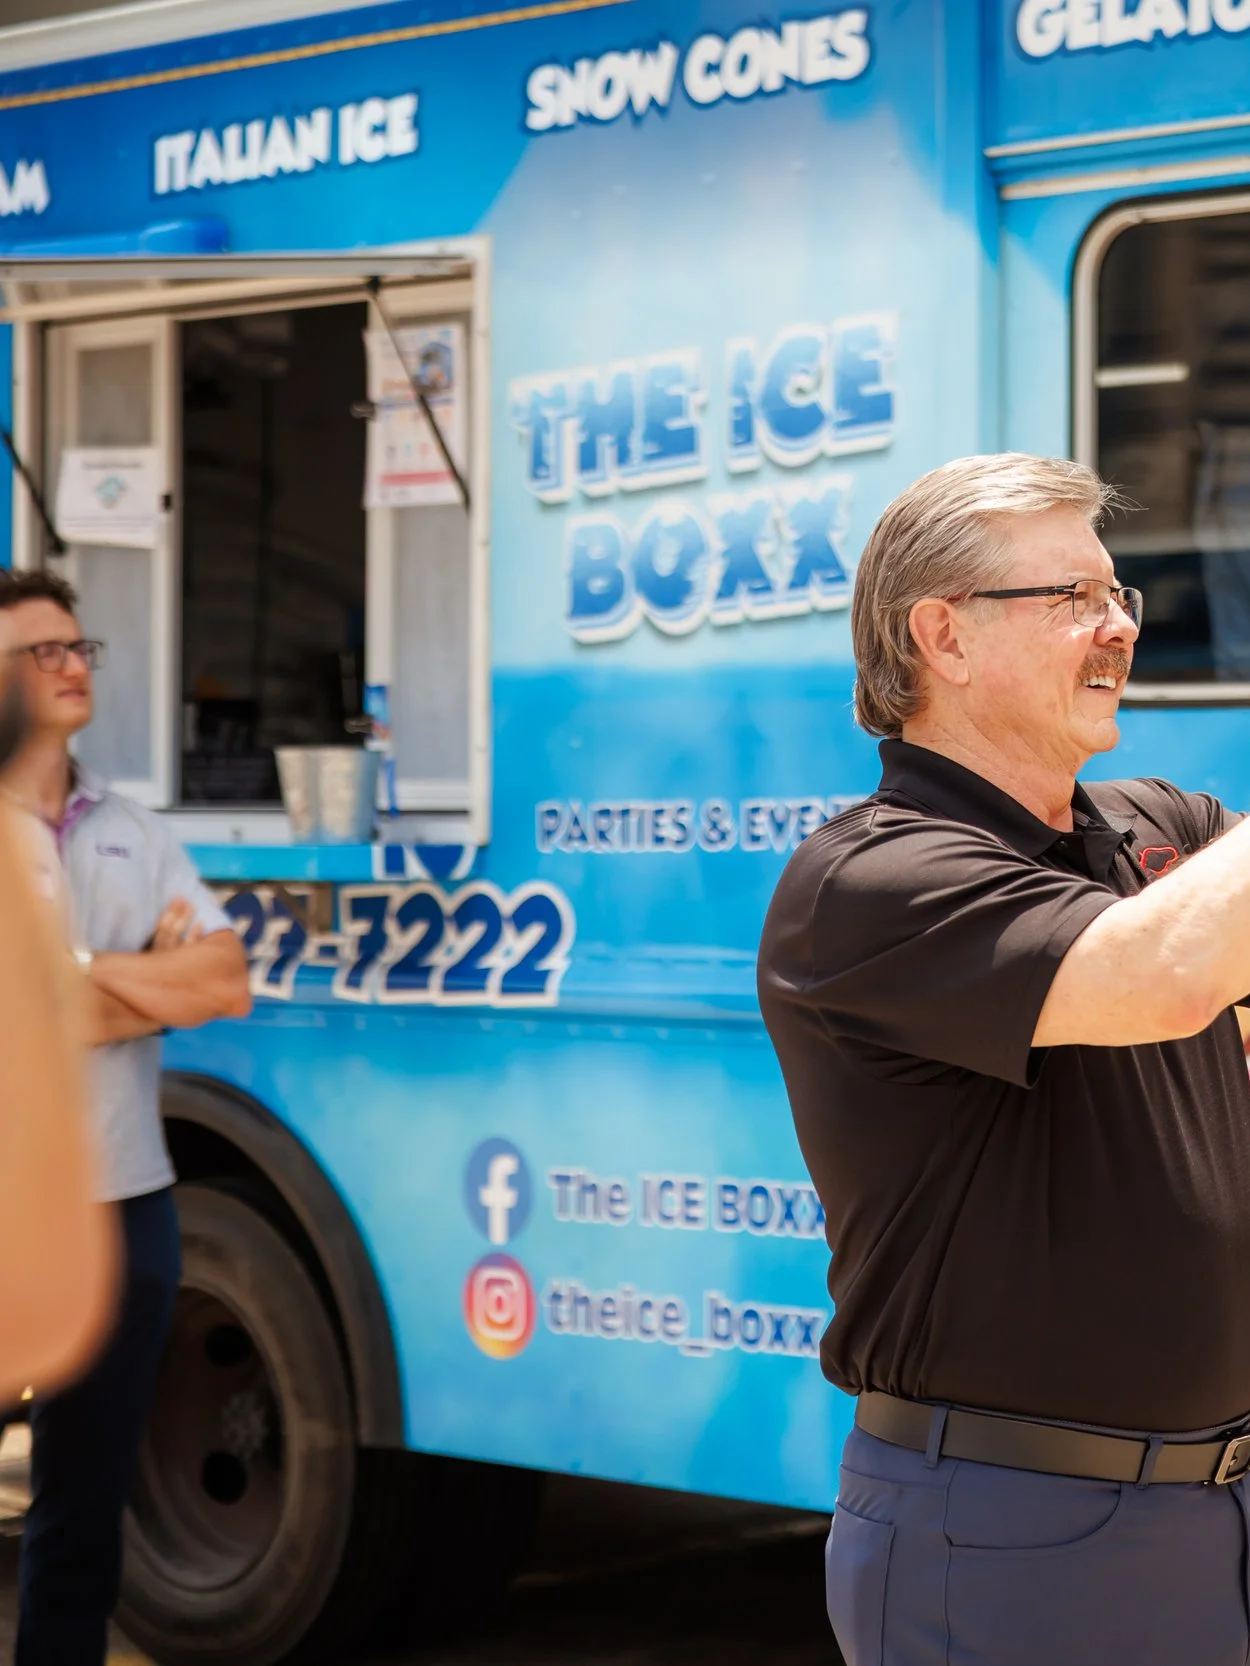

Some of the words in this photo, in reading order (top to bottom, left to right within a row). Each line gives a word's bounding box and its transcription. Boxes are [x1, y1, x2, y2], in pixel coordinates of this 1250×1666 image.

[525, 41, 680, 131] SNOW
[683, 9, 871, 105] CONES
[154, 106, 333, 195] ITALIAN
[338, 92, 419, 166] ICE
[508, 347, 708, 505] THE
[724, 309, 899, 475] ICE
[561, 472, 854, 646] BOXX
[535, 797, 697, 854] PARTIES
[697, 796, 738, 853] &
[547, 1167, 633, 1227] The
[638, 1172, 707, 1231] ICE
[711, 1176, 827, 1241] BOXX
[545, 1278, 827, 1360] theice_boxx
